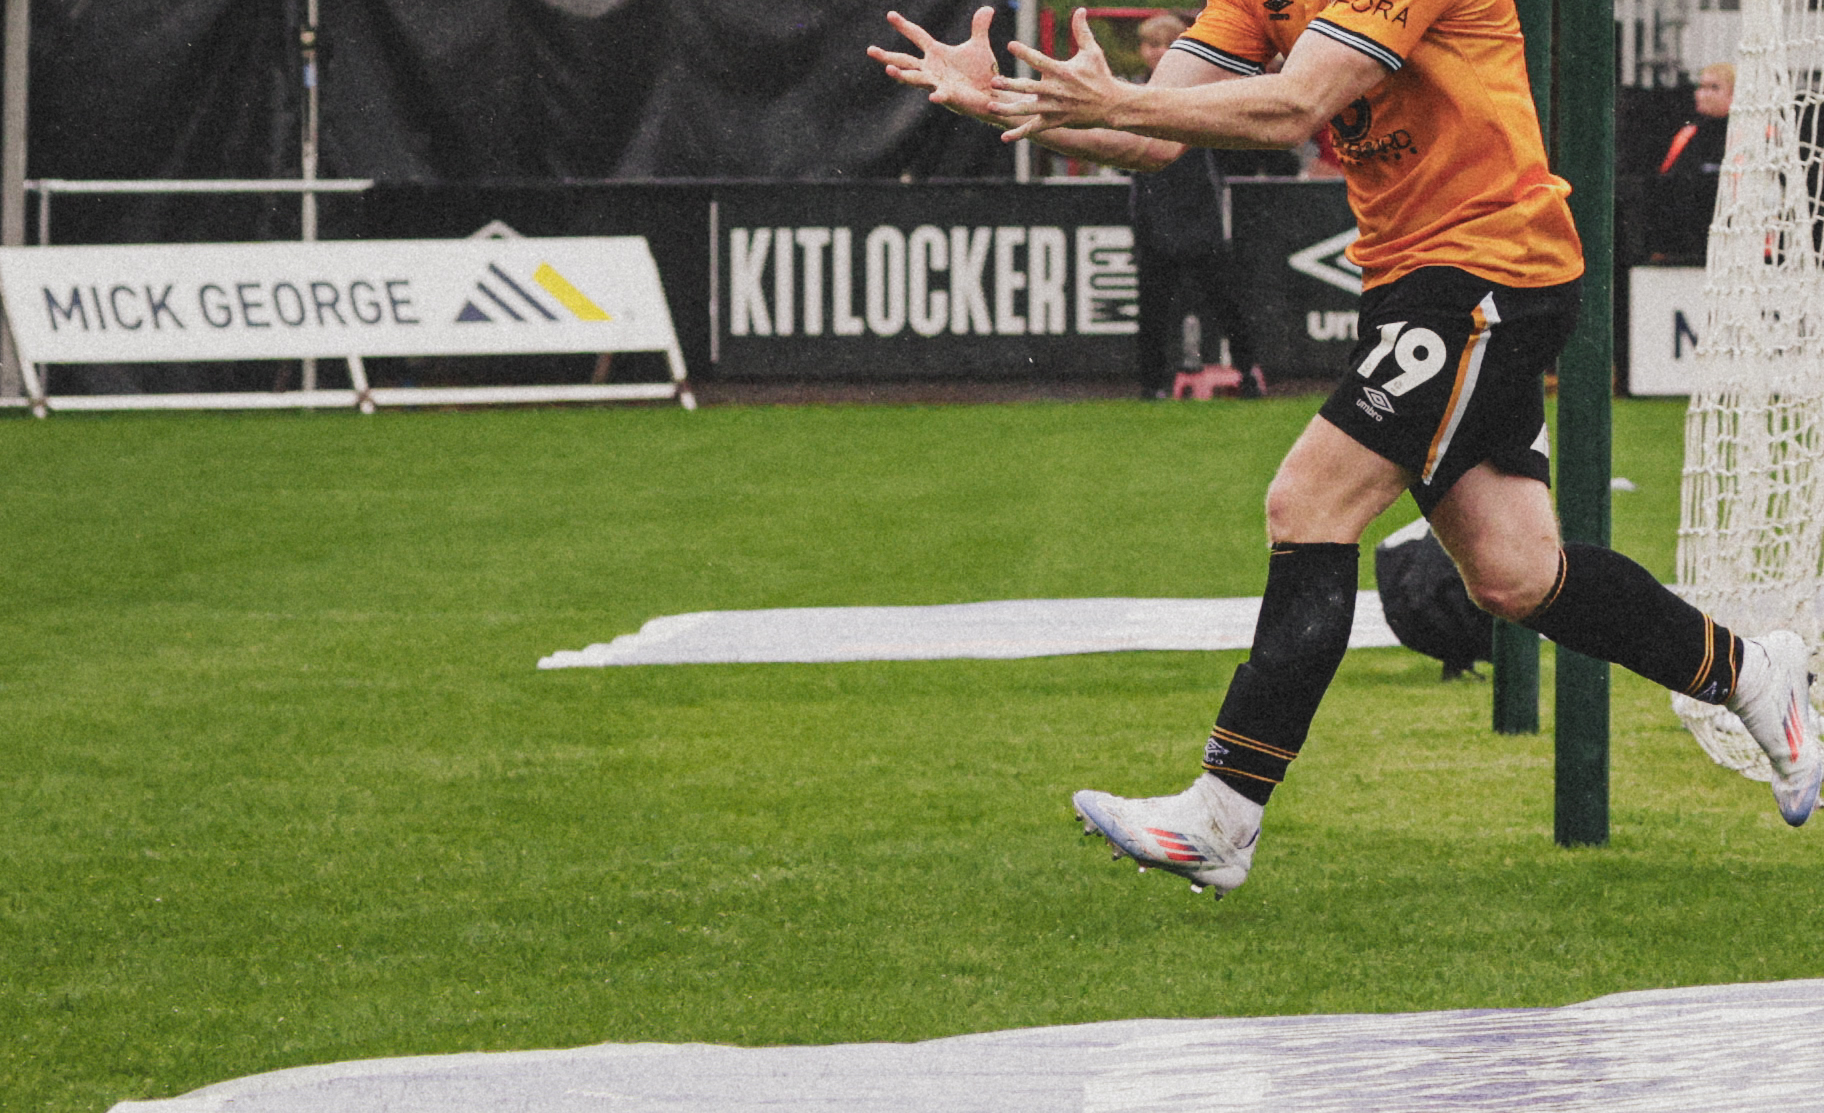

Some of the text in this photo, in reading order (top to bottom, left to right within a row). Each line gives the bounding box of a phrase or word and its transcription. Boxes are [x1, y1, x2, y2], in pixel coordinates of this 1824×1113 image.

[42, 279, 420, 331] MICK GEORGE
[730, 224, 1067, 336] KITLOCKER
[1356, 320, 1447, 397] 19
[1355, 398, 1384, 422] umbro
